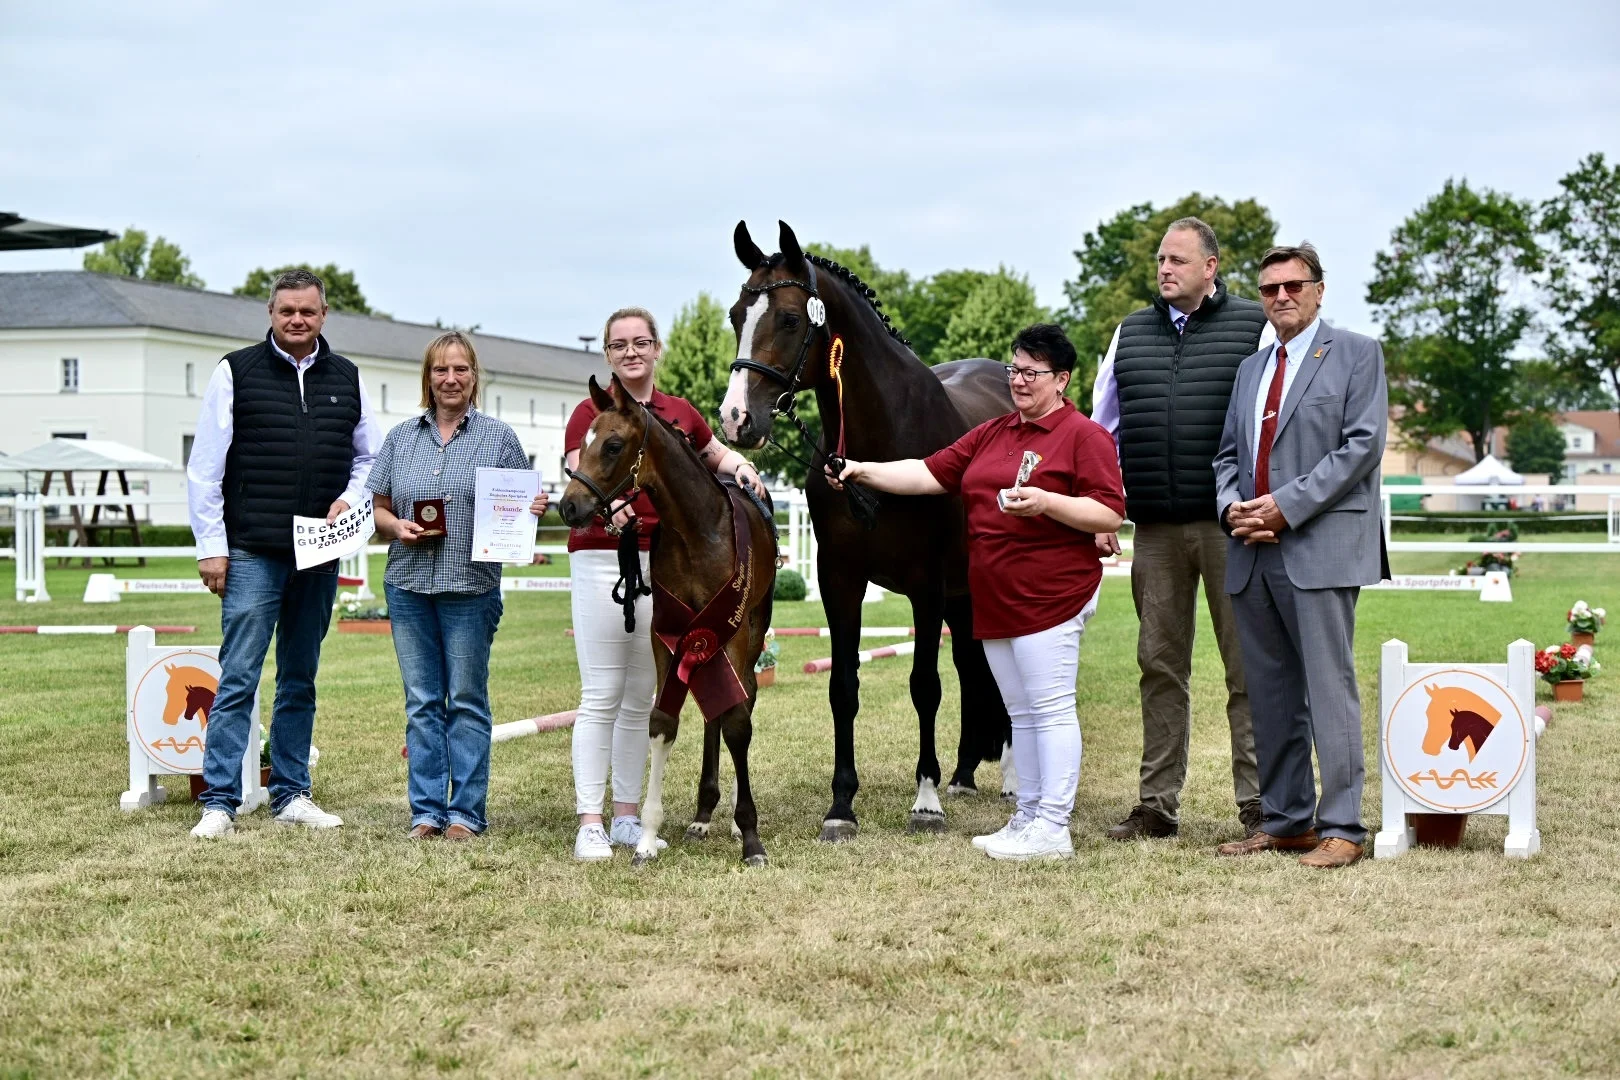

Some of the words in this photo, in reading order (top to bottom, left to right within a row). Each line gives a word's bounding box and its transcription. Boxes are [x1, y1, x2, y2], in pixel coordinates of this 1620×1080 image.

[810, 301, 824, 322] 016
[296, 499, 371, 535] DECKGELD
[493, 505, 523, 513] Urkunde
[297, 508, 372, 547] GUTSCHEIN
[1404, 577, 1461, 588] Sportpferd
